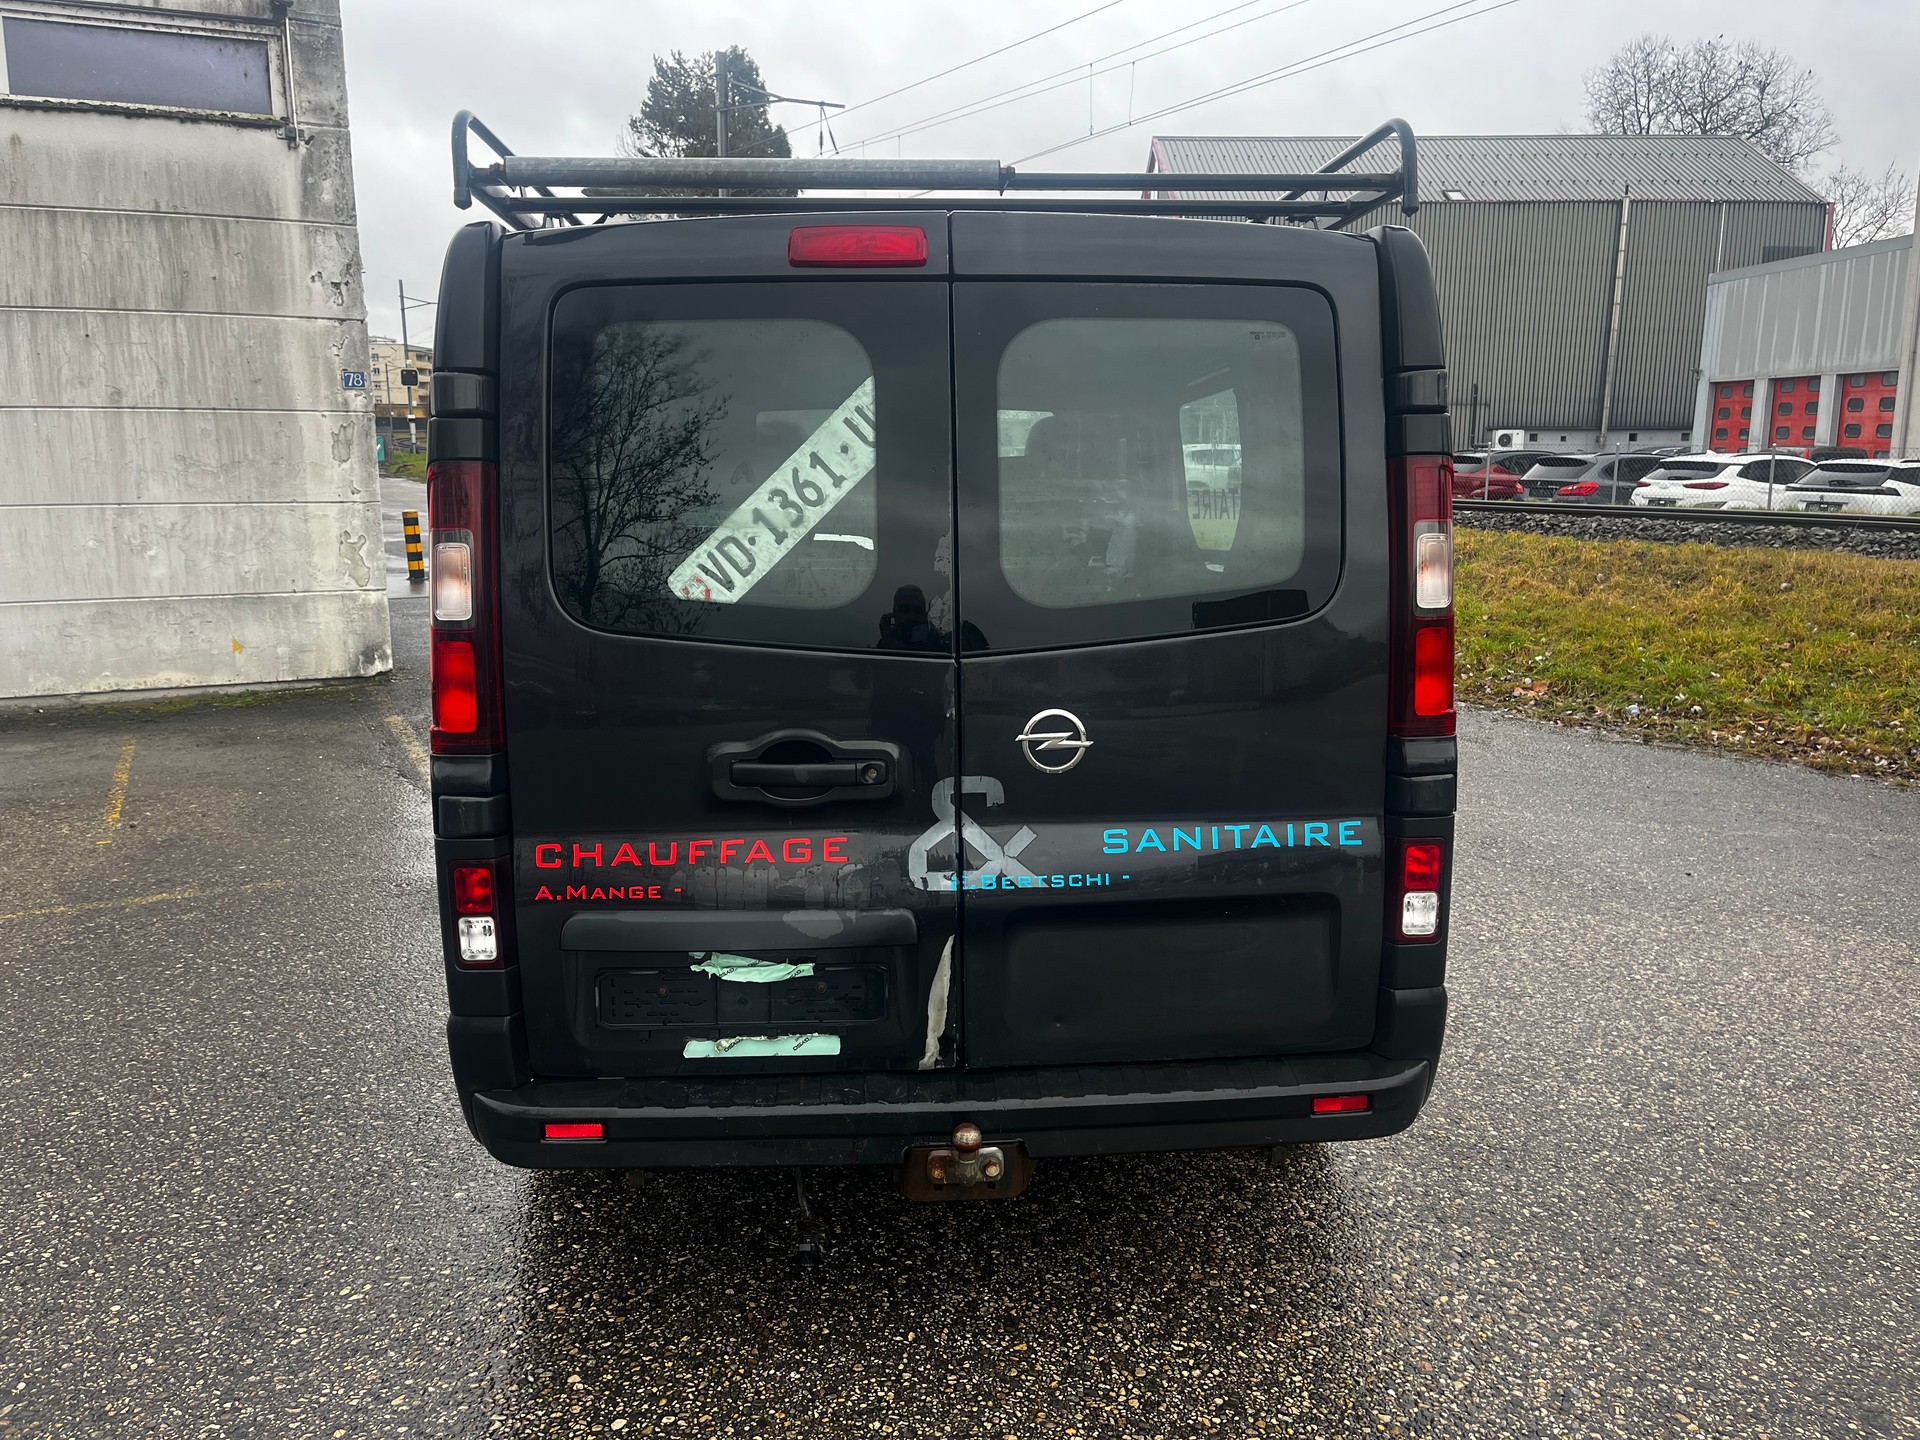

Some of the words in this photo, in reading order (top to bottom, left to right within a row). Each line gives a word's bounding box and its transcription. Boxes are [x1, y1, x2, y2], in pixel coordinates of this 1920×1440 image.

[344, 372, 363, 387] 78
[534, 837, 849, 869] CHAUFFAGE
[908, 775, 1039, 892] &
[1102, 820, 1363, 854] SANITAIRE
[534, 885, 662, 901] A.MANGE
